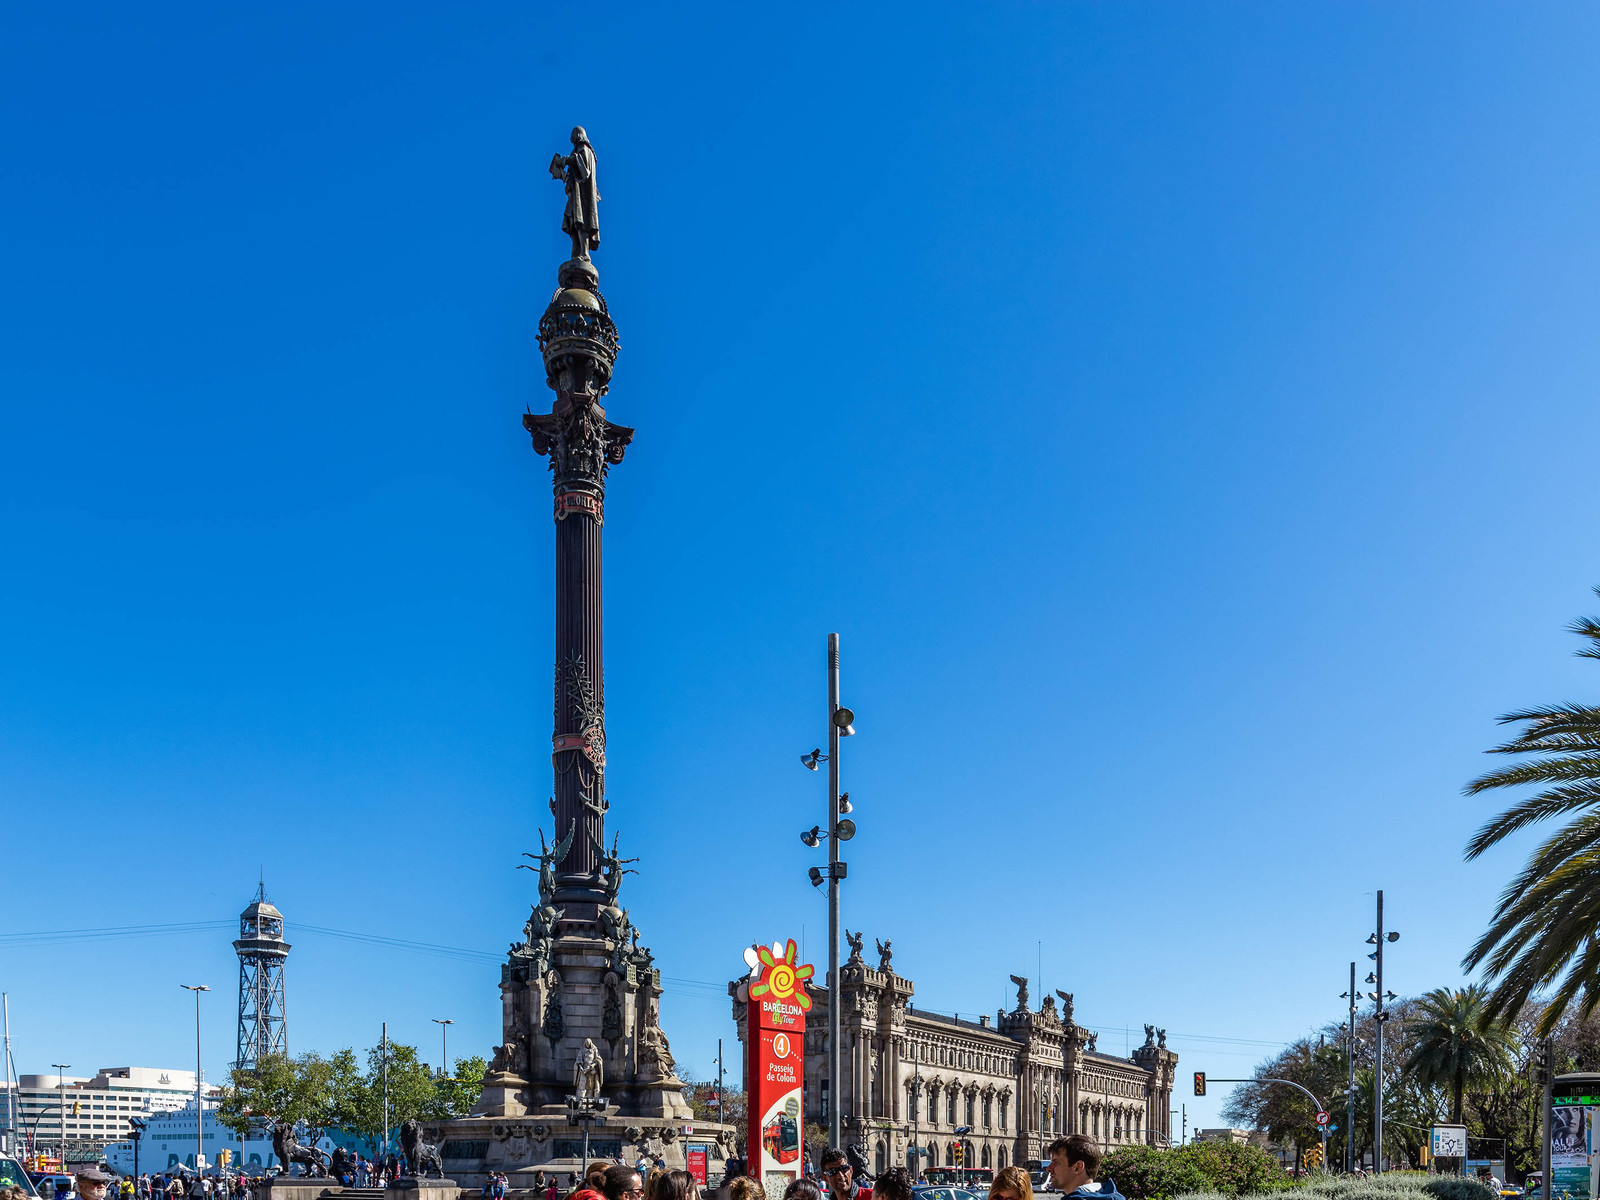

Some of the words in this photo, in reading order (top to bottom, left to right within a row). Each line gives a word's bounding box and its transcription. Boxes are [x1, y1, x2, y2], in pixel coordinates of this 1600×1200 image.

[565, 495, 595, 509] GLORIA
[763, 1001, 803, 1016] BARCELONA
[782, 1014, 796, 1025] Tour
[777, 1037, 785, 1053] 4
[769, 1062, 794, 1075] Passeig
[766, 1072, 775, 1082] de
[776, 1072, 797, 1084] Colom
